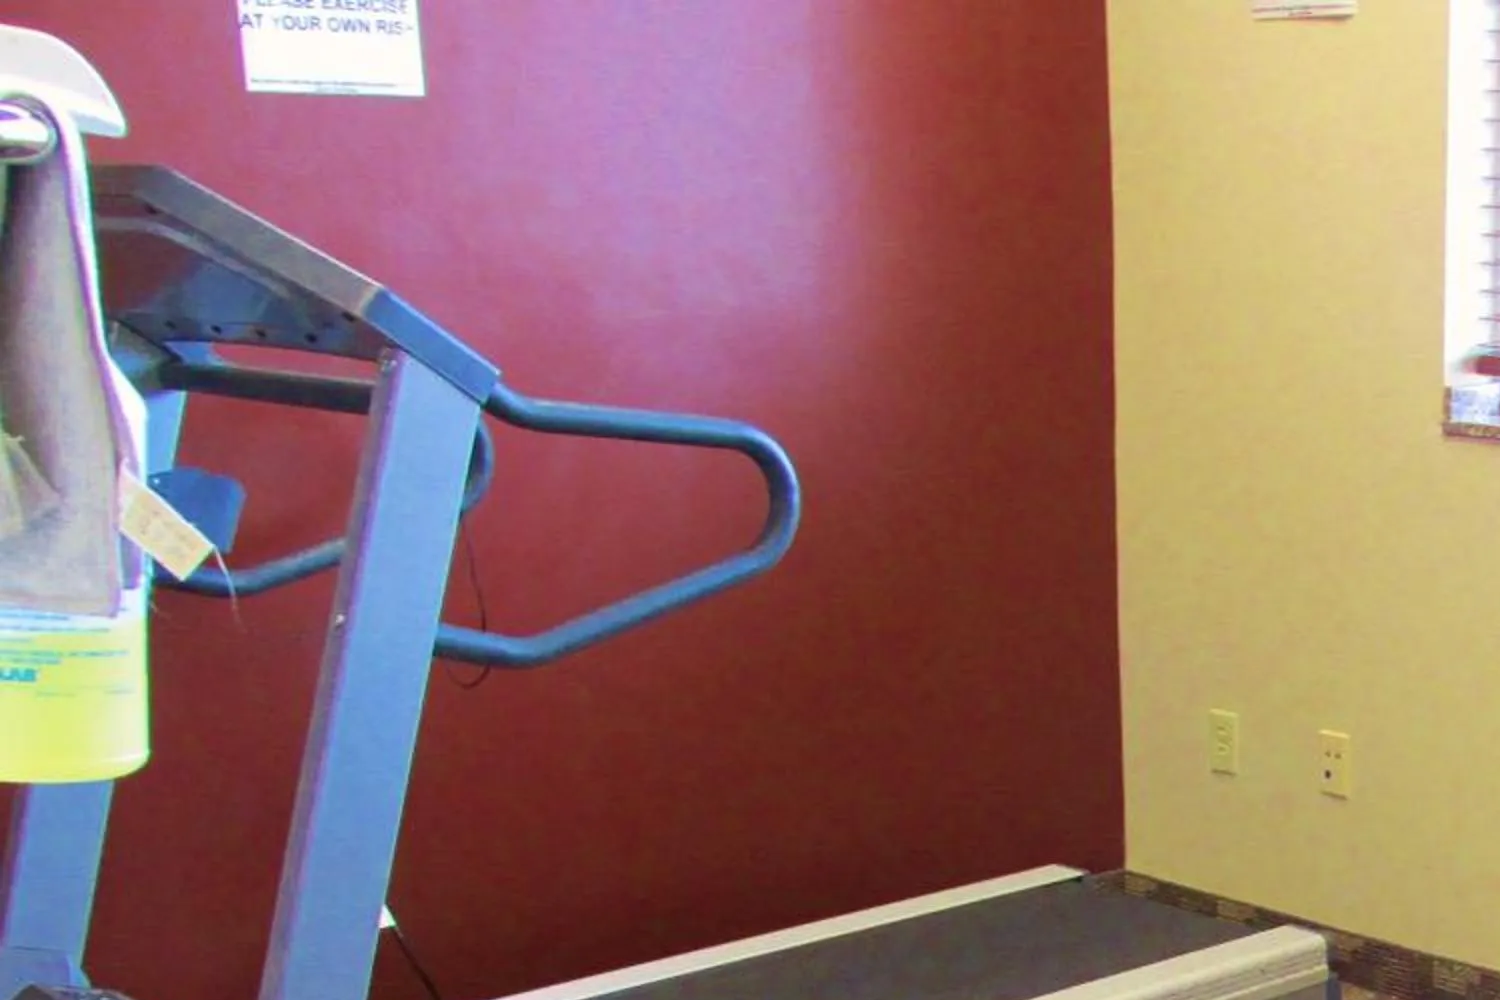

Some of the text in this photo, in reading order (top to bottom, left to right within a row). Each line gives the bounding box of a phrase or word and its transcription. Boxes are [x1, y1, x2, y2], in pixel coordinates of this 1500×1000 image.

[241, 13, 263, 28] AT
[273, 15, 322, 31] YOUR
[327, 17, 371, 33] OWN
